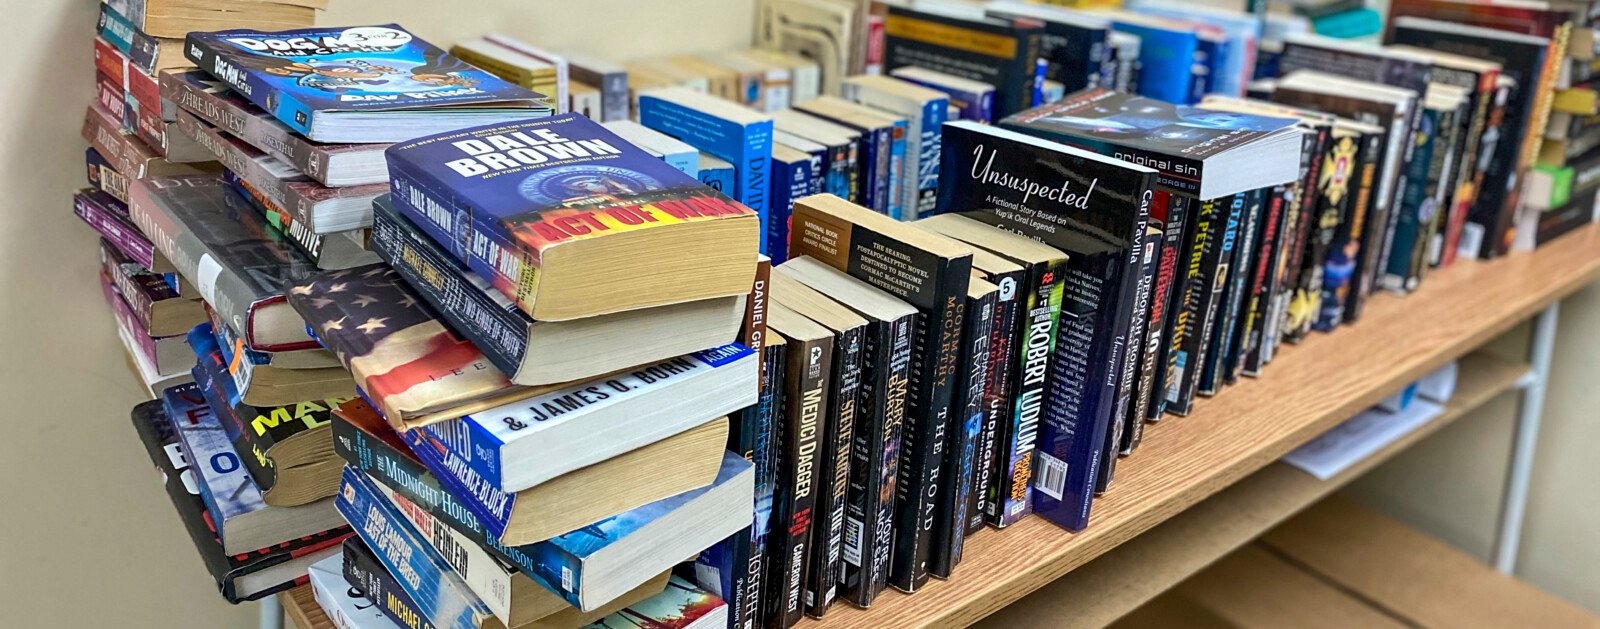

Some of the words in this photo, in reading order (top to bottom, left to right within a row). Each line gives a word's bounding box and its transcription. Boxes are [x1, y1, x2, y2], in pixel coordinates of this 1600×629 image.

[226, 36, 315, 51] DOG
[349, 33, 368, 41] 3
[214, 55, 228, 79] DOG
[225, 64, 239, 86] MAN
[181, 85, 220, 120] THREADS
[221, 108, 247, 135] WEST
[195, 122, 227, 157] THREADS
[226, 147, 248, 175] WEST
[261, 131, 294, 158] ROSENTHAL
[418, 138, 436, 146] BEST
[438, 132, 470, 142] MILITARY
[470, 127, 499, 136] WRITER
[521, 120, 552, 128] COUNTRY
[451, 128, 570, 156] DALE
[445, 138, 622, 177] BROWN
[482, 171, 500, 180] NEW
[501, 167, 522, 176] YORK
[523, 163, 544, 171] TIMES
[544, 157, 592, 168] BESTSELLING
[592, 154, 621, 162] AUTHOR
[970, 144, 1098, 210] Unsuspected
[1113, 151, 1171, 171] original
[1174, 163, 1198, 176] sin
[748, 157, 765, 212] DAVID
[1140, 189, 1153, 220] Carl
[409, 184, 426, 214] DALE
[426, 197, 452, 233] BROWN
[532, 211, 611, 242] ACT
[605, 203, 660, 226] OF
[653, 196, 747, 220] WAR
[804, 220, 825, 234] NATIONAL
[825, 228, 839, 238] BOOK
[985, 194, 992, 202] A
[991, 196, 1019, 211] Fictional
[1019, 205, 1037, 217] Story
[1037, 209, 1057, 222] Based
[1057, 218, 1067, 226] on
[995, 207, 1013, 223] Yup'ik
[1013, 212, 1029, 226] Oral
[1029, 217, 1056, 234] Legends
[473, 230, 489, 258] ACT
[488, 242, 500, 267] OF
[499, 247, 520, 282] WAR
[802, 237, 818, 248] AWARD
[818, 243, 838, 256] FINALIST
[804, 229, 820, 240] CRITICS
[821, 235, 837, 247] CIRCLE
[873, 242, 885, 250] THE
[885, 246, 913, 263] SEARING,
[1129, 221, 1147, 265] Pavilla
[1188, 220, 1210, 279] PETRIE
[527, 266, 537, 296] AUTHOR
[857, 244, 907, 269] POSTAPOCALYPTIC
[907, 267, 929, 279] NOVEL
[860, 255, 889, 270] DESTINED
[889, 265, 897, 273] TO
[897, 270, 923, 285] BECOME
[860, 264, 884, 278] CORMAC
[884, 275, 920, 294] McCARTHY'S
[1071, 268, 1082, 276] will
[1081, 272, 1092, 280] take
[1091, 276, 1103, 285] you
[752, 280, 765, 328] DANIEL
[868, 276, 909, 297] MASTERPIECE.
[1003, 281, 1010, 294] 5
[1134, 274, 1152, 335] DEBORAH
[1151, 246, 1178, 325] PATTERSON
[463, 296, 476, 319] TWO
[474, 305, 492, 335] KINDS
[491, 321, 502, 340] OF
[500, 327, 520, 357] TRUTH
[1030, 304, 1058, 318] BESTSELLING
[1034, 313, 1051, 323] AUTHOR
[705, 344, 746, 363] AGAIN.
[937, 295, 957, 387] McCARTHY
[947, 303, 964, 375] CORMAC
[983, 305, 1003, 399] RICHARDSON
[996, 338, 1007, 363] KAT
[1024, 320, 1052, 386] ROBERT
[1148, 330, 1161, 353] 10
[428, 362, 487, 381] LEE
[967, 335, 987, 407] EMLEY
[1107, 335, 1125, 388] Unsuspected
[1126, 336, 1141, 391] CROMBIE
[1145, 354, 1154, 371] TH
[503, 416, 528, 431] &
[532, 386, 610, 422] JAMES
[612, 379, 638, 393] O.
[638, 356, 698, 385] BORN
[800, 388, 822, 438] MEDICI
[884, 373, 898, 442] BURTON
[892, 378, 908, 425] MARY
[1050, 404, 1065, 415] might
[1064, 410, 1077, 419] have
[838, 399, 854, 441] STEVE
[933, 406, 948, 455] THE
[1016, 387, 1043, 456] LUDLUM
[1058, 424, 1075, 434] When
[376, 454, 385, 472] THE
[795, 440, 817, 501] DAGGER
[833, 443, 850, 502] MARTINI
[977, 399, 999, 510] UNDERGROUND
[1087, 450, 1100, 484] Publication
[385, 455, 440, 507] MIDNIGHT
[440, 490, 481, 534] HOUSE
[443, 449, 482, 497] LAWRENCE
[479, 481, 509, 521] BLOCK
[1011, 459, 1023, 501] DECEPTION
[1017, 451, 1032, 502] PROMETHEUS
[368, 503, 386, 528] LOUIS
[831, 504, 843, 531] THE
[924, 466, 940, 531] ROAD
[1081, 483, 1092, 518] Consultants
[875, 509, 886, 543] NOT
[880, 513, 893, 565] YOU'RE
[364, 519, 382, 544] LAST
[377, 533, 389, 553] OF
[387, 543, 400, 568] THE
[398, 559, 421, 590] BREED
[433, 516, 469, 581] HEINLEIN
[790, 543, 804, 594] CAMERON
[828, 528, 840, 567] JURY
[871, 540, 884, 582] SAFE
[734, 578, 743, 622] Publication
[745, 553, 762, 616] JOSEPH
[788, 592, 799, 613] WEST
[387, 591, 421, 629] MICHAEL
